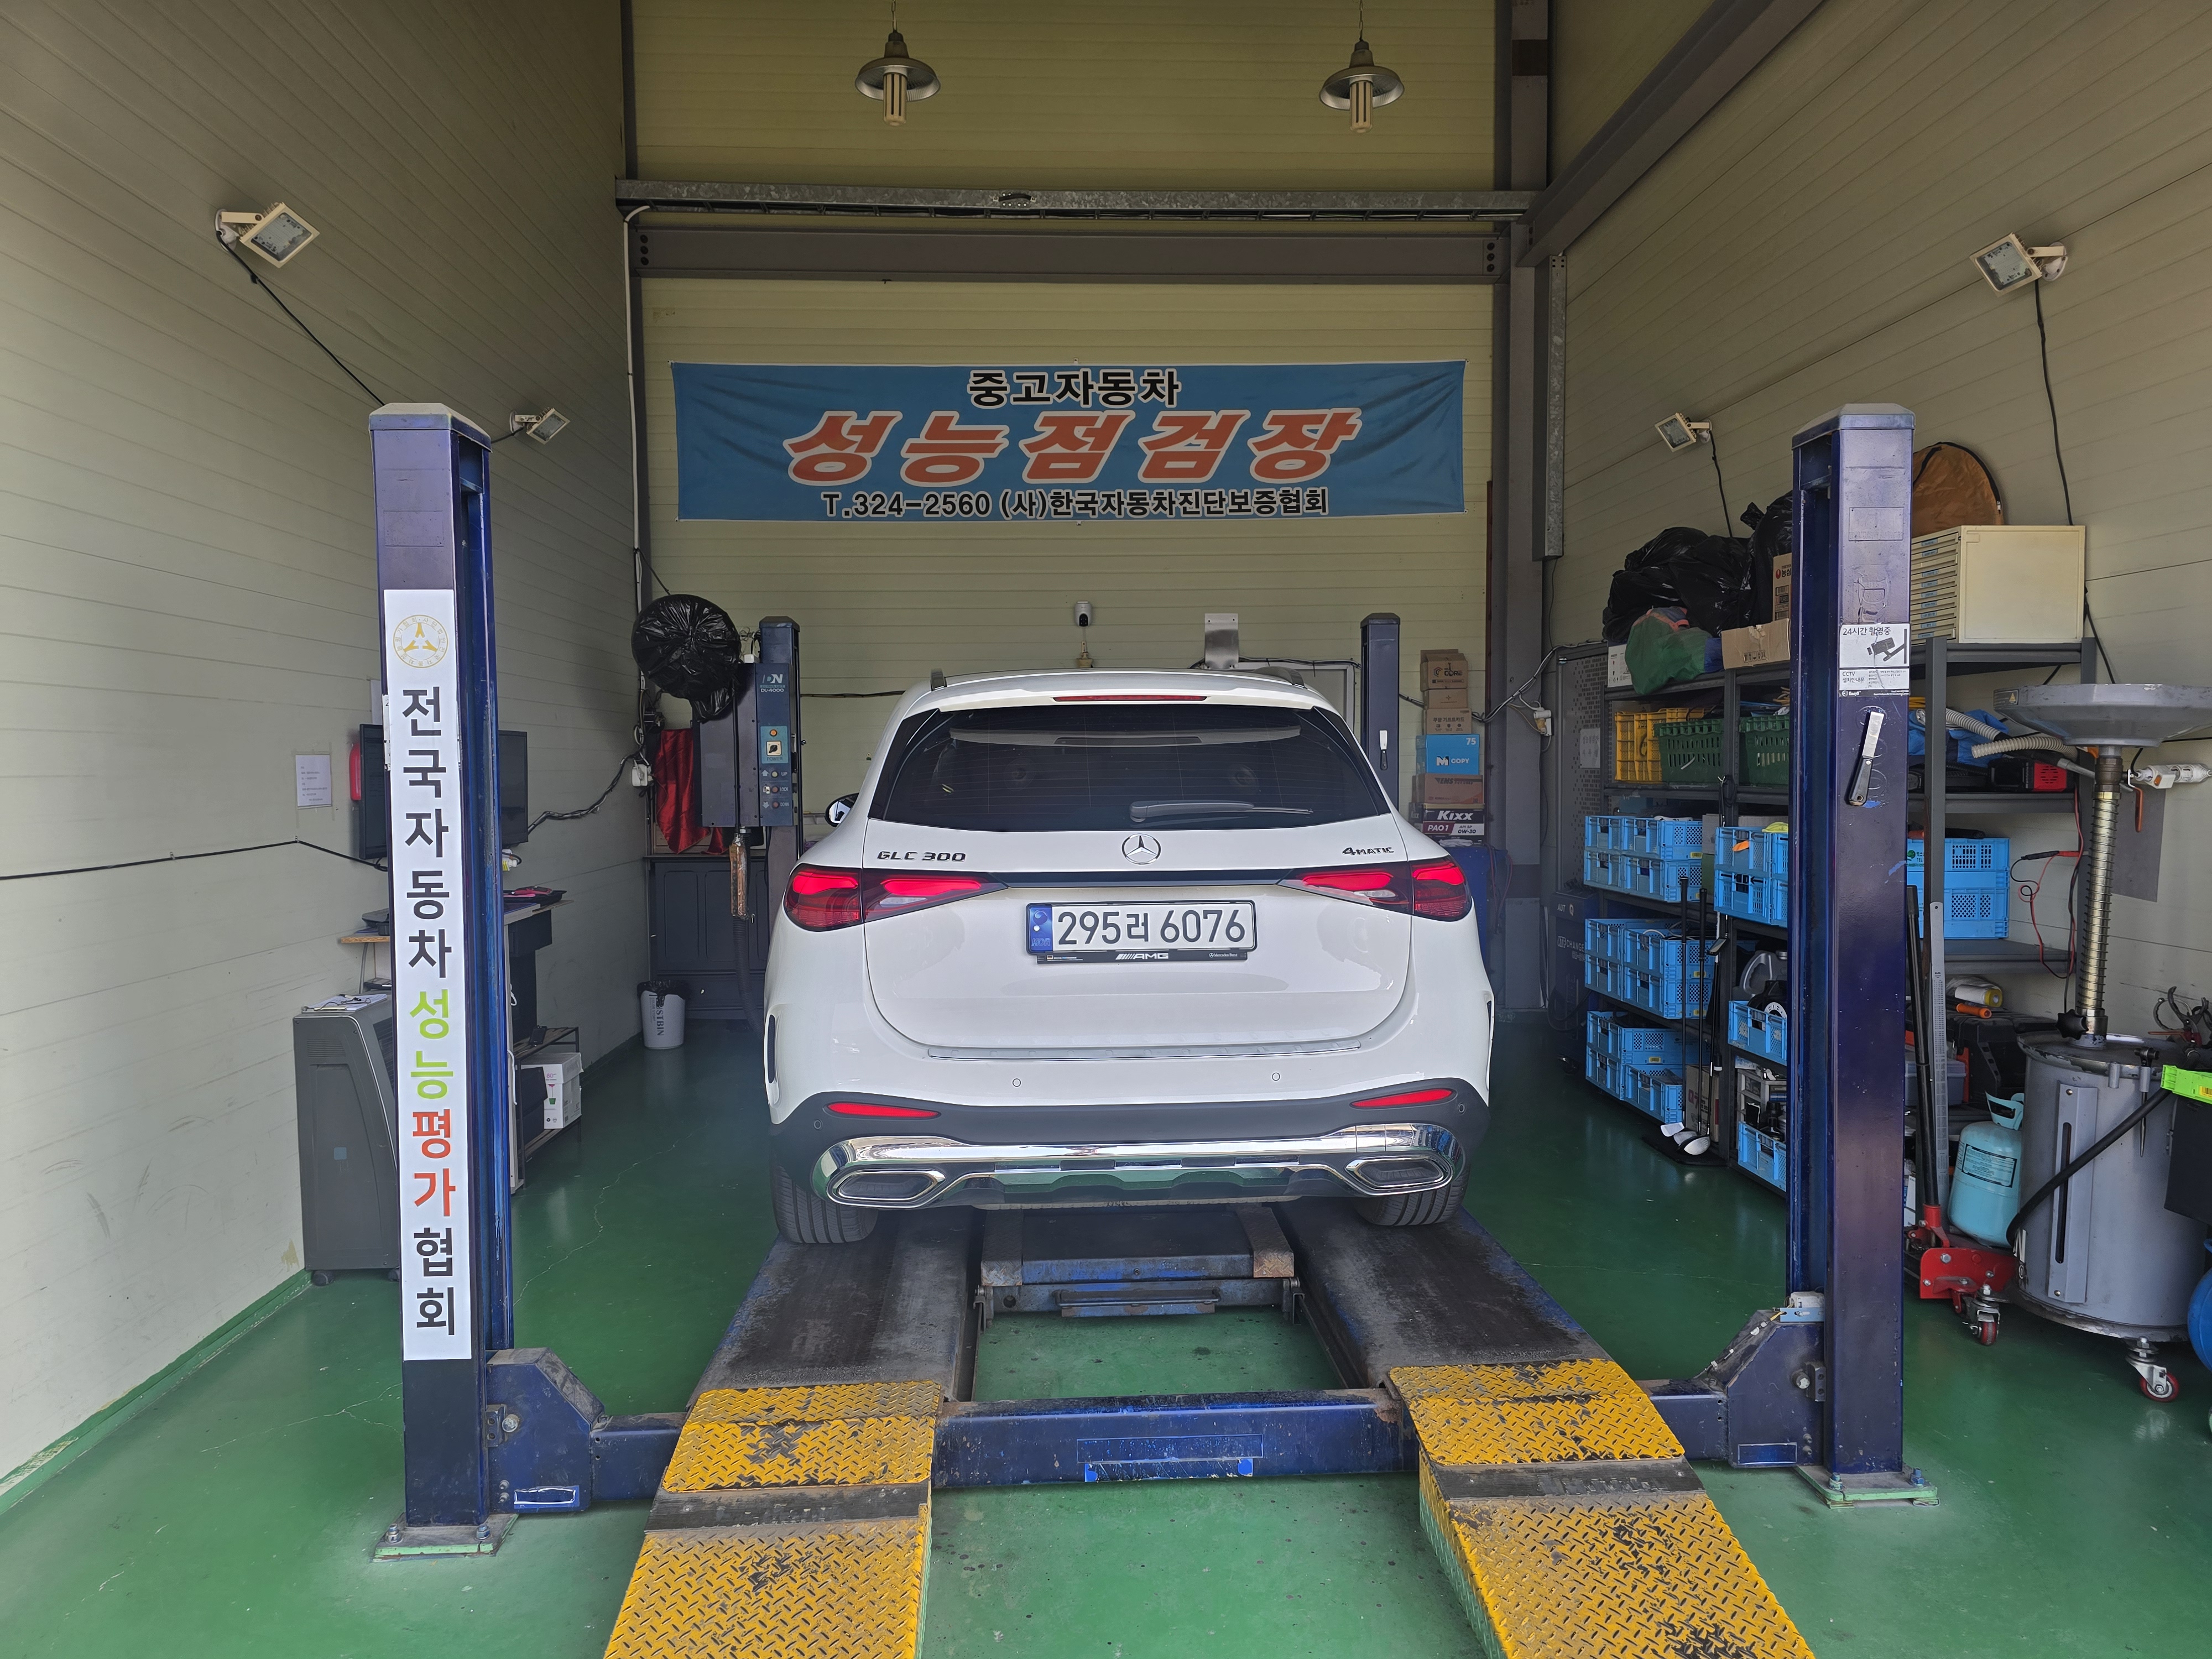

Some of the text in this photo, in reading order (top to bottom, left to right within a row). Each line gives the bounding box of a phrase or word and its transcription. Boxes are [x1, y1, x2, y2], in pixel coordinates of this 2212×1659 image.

[968, 369, 1181, 408] 중고자동차
[783, 408, 1362, 487] 성능점검장
[822, 487, 1328, 519] T.324-2560 (사)한국자동차진단보증협회
[1843, 627, 1891, 636] 24시간 촬영중
[1437, 810, 1473, 820] Kixx
[877, 851, 966, 862] GLC 300
[1031, 937, 1051, 946] KOR
[1058, 910, 1245, 945] 295리 6076
[656, 1006, 665, 1036] STBIN
